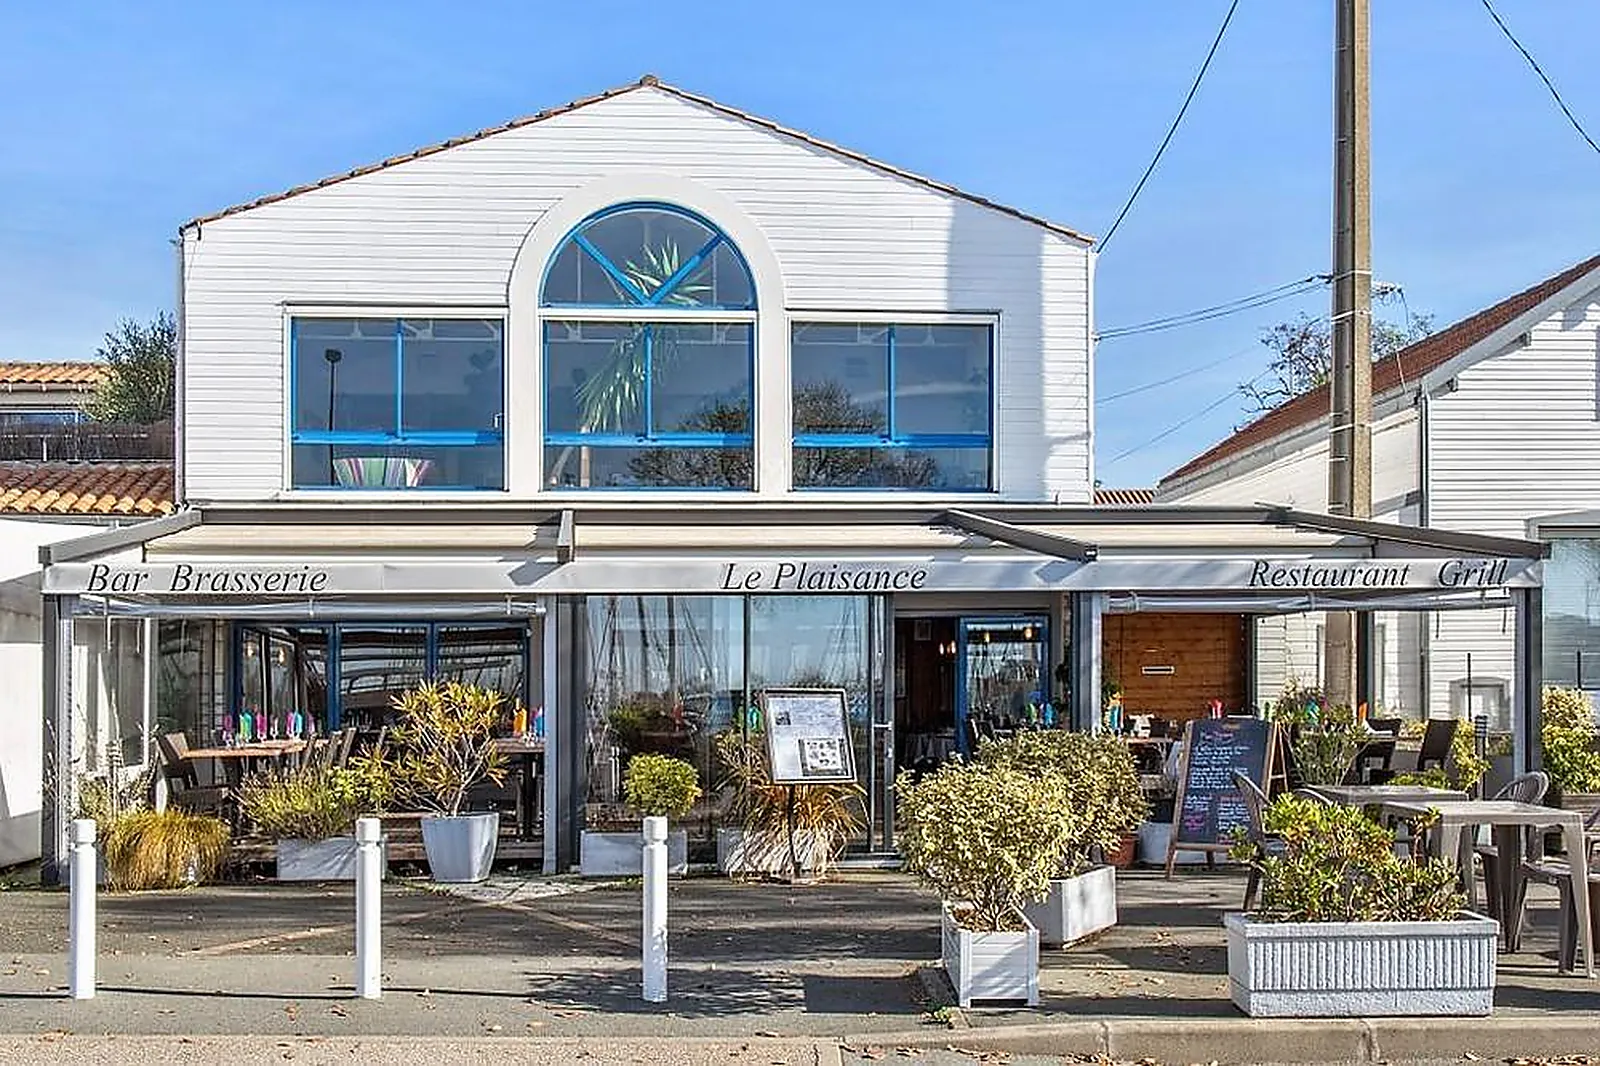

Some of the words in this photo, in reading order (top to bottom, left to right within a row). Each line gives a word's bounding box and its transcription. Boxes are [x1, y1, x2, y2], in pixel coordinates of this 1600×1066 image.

[87, 563, 149, 592] Bar
[170, 563, 328, 592] Brasserie
[720, 562, 763, 590] Le
[770, 562, 928, 590] Plaisance
[1248, 559, 1411, 587] Restaurant
[1437, 558, 1509, 587] Grill
